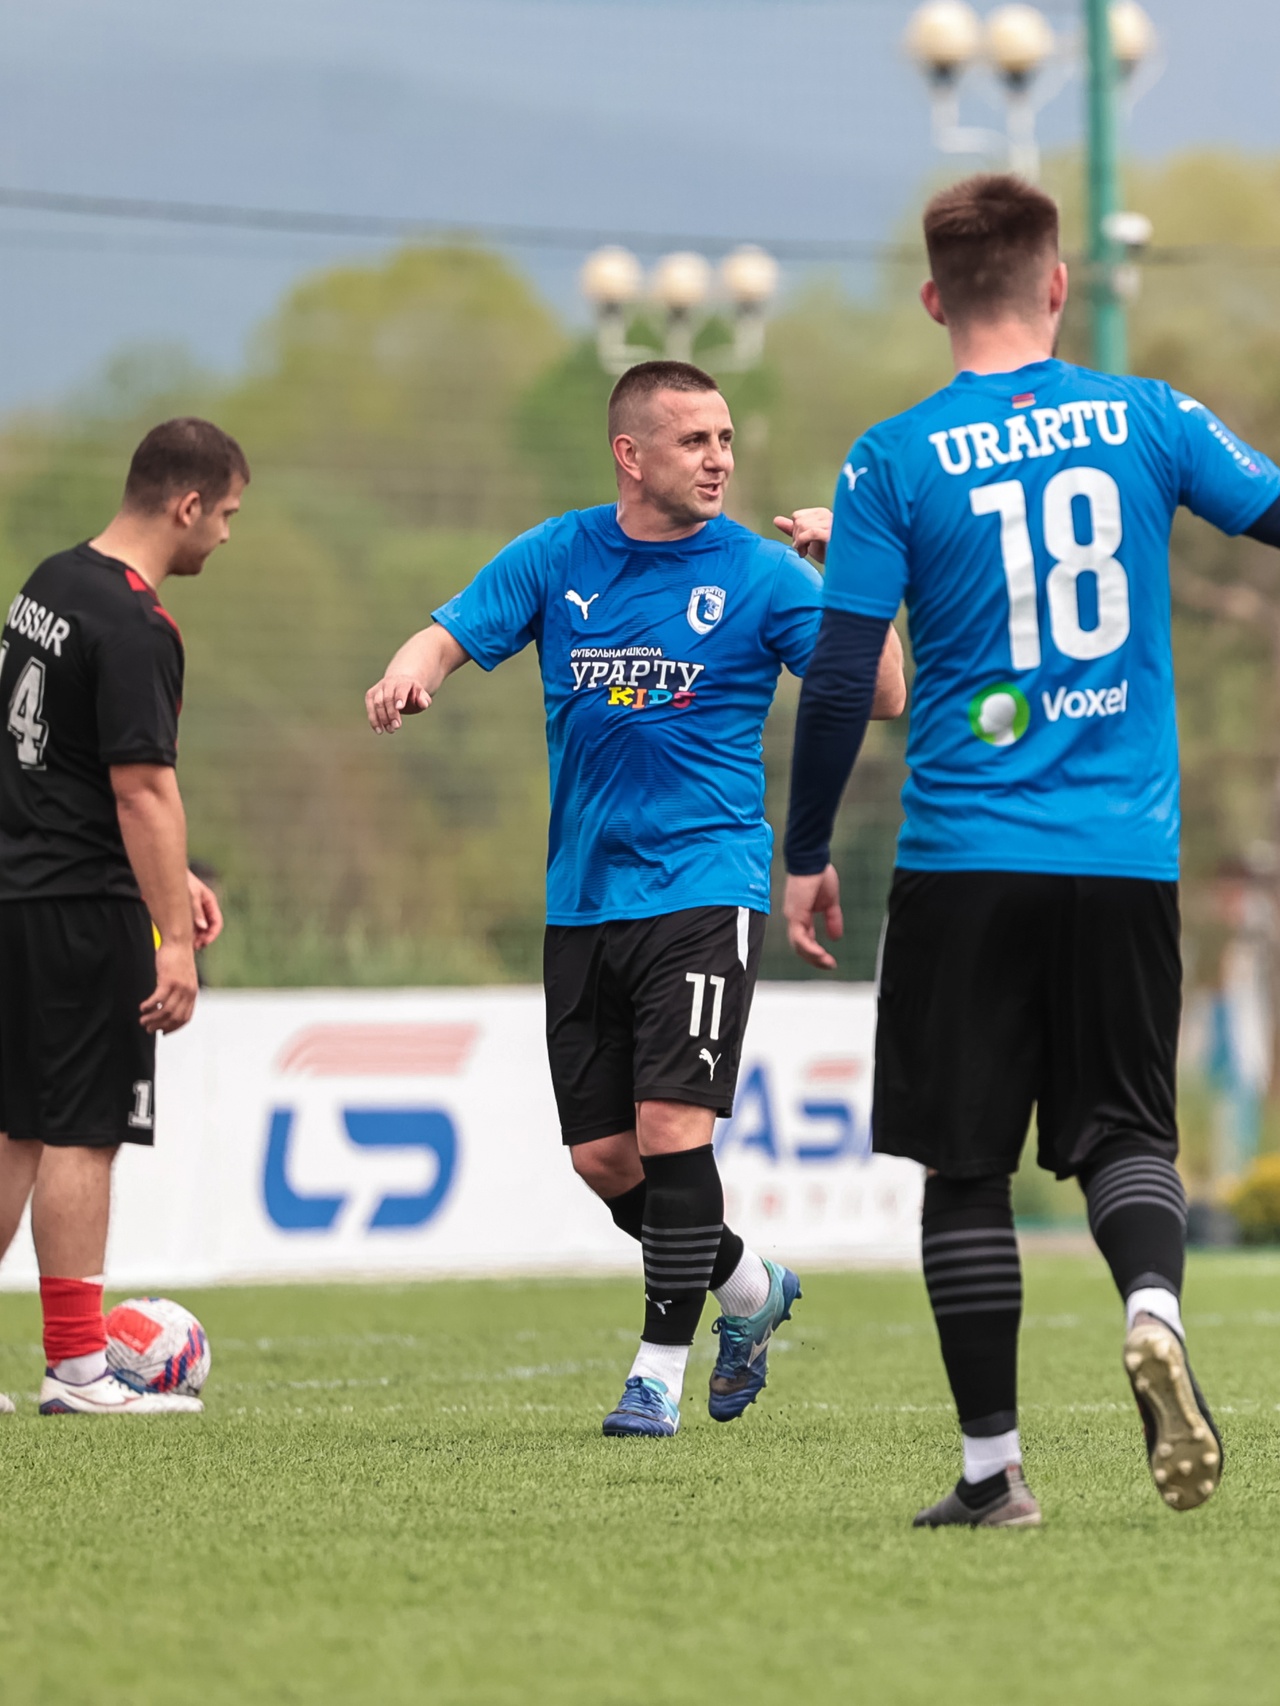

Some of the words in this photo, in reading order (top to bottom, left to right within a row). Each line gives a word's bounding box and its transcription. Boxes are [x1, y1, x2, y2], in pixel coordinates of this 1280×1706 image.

[929, 400, 1129, 475] URARTU
[969, 466, 1131, 671] 18
[625, 647, 663, 657] ШКОЛА
[570, 660, 705, 692] УРАРТУ
[607, 686, 697, 709] KIDS
[1042, 679, 1128, 722] Voxel
[685, 972, 726, 1040] 11
